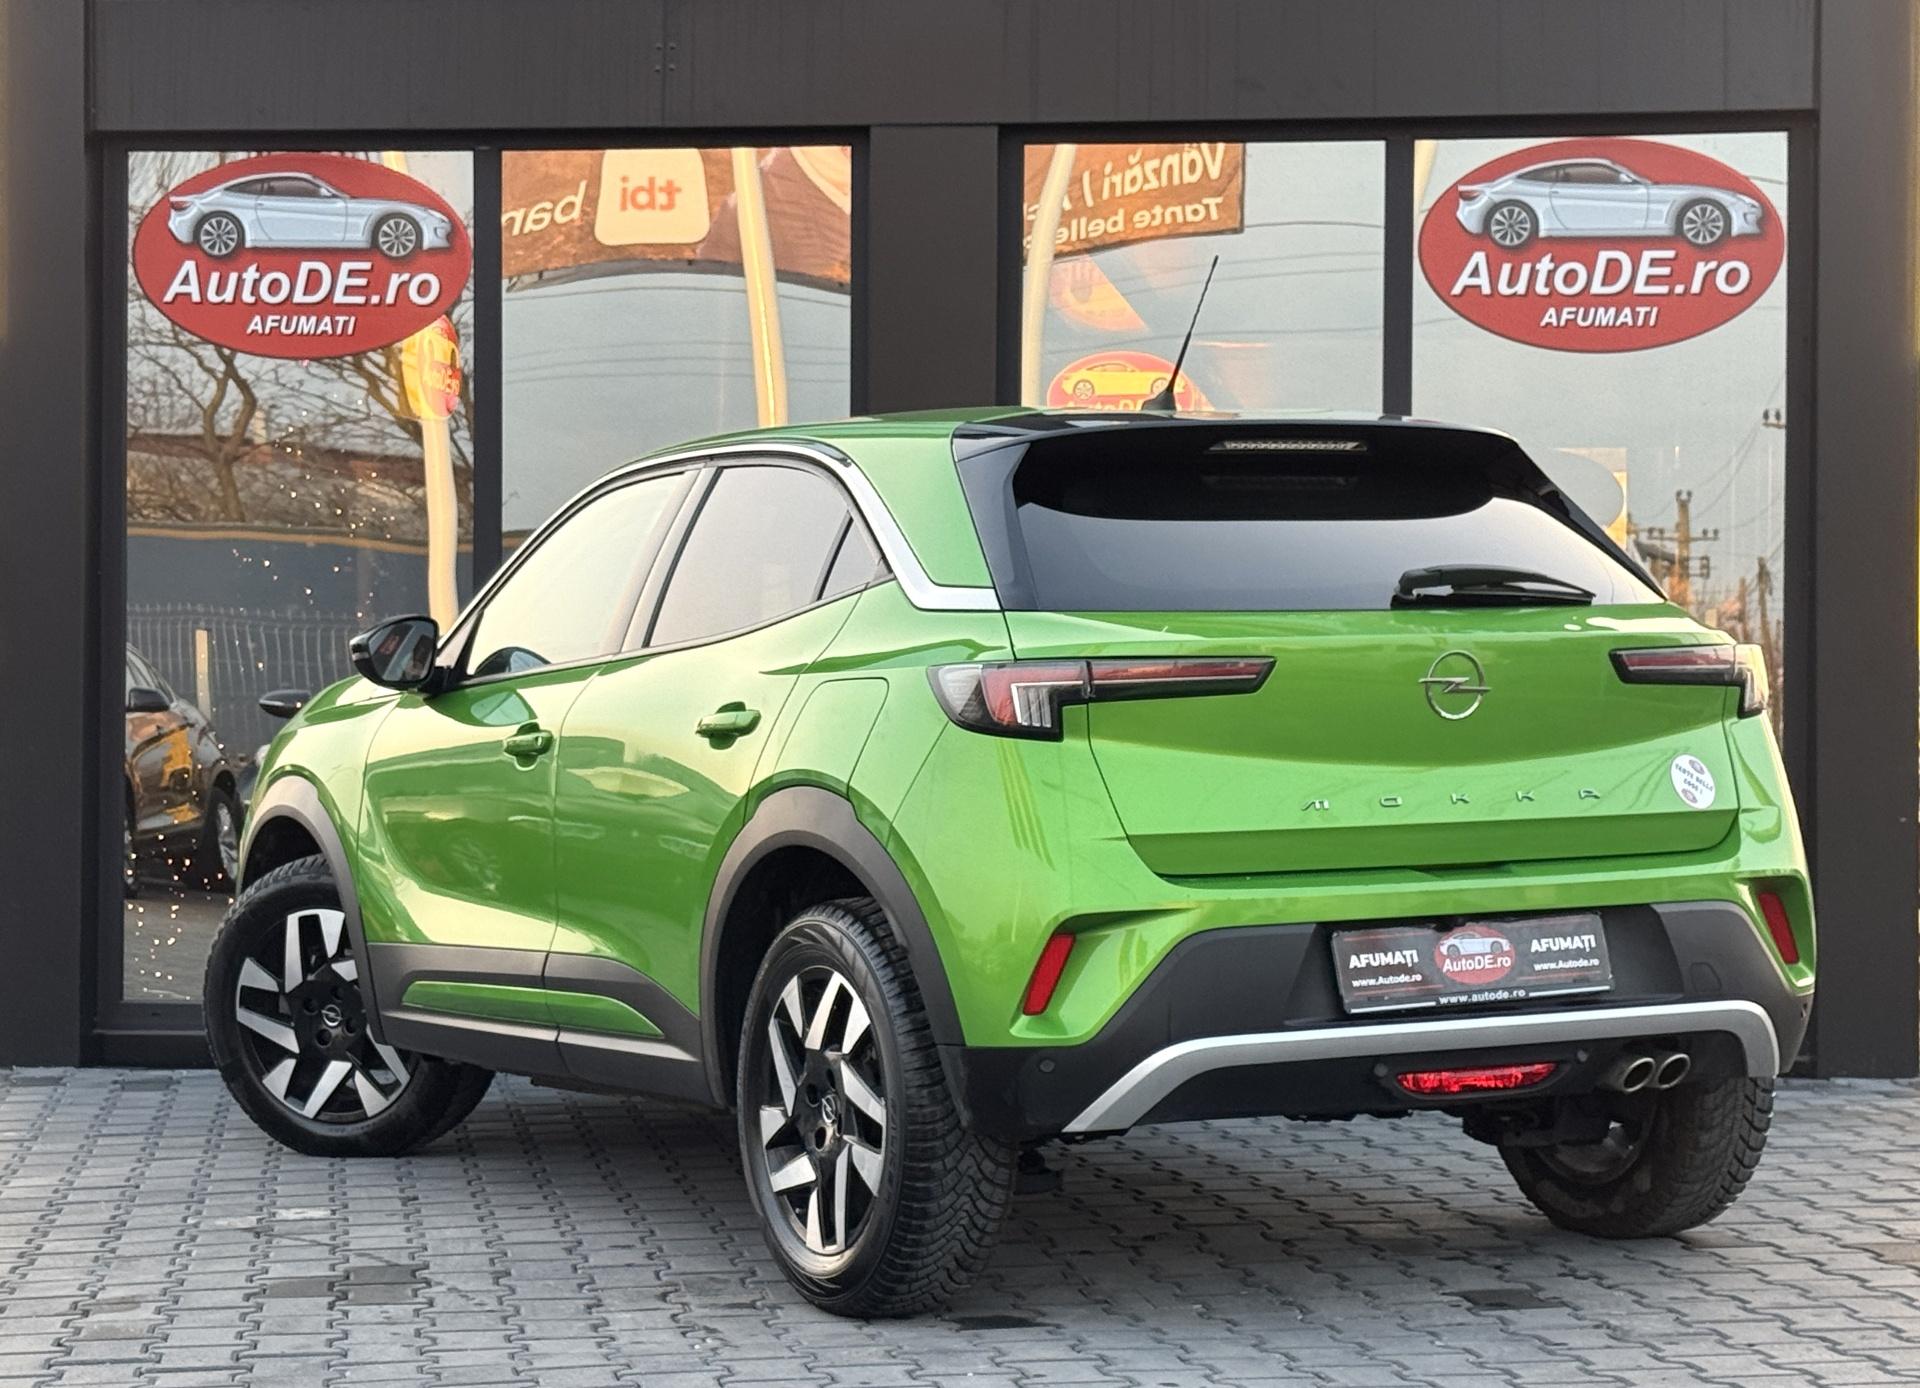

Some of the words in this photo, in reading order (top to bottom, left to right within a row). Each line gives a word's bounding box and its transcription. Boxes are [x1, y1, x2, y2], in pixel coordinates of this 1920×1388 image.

[163, 260, 441, 306] AutoDE.ro
[1450, 249, 1751, 297] AutoDE.ro
[246, 315, 356, 336] AFUMATI
[1540, 306, 1660, 328] AFUMATI
[1302, 787, 1601, 811] MOKKA
[1442, 954, 1512, 973] AutoDE.ro
[1533, 957, 1600, 972] www.Autode.ro
[1351, 973, 1423, 988] www.Autode.ro
[1438, 988, 1527, 1005] www.autode.ro
